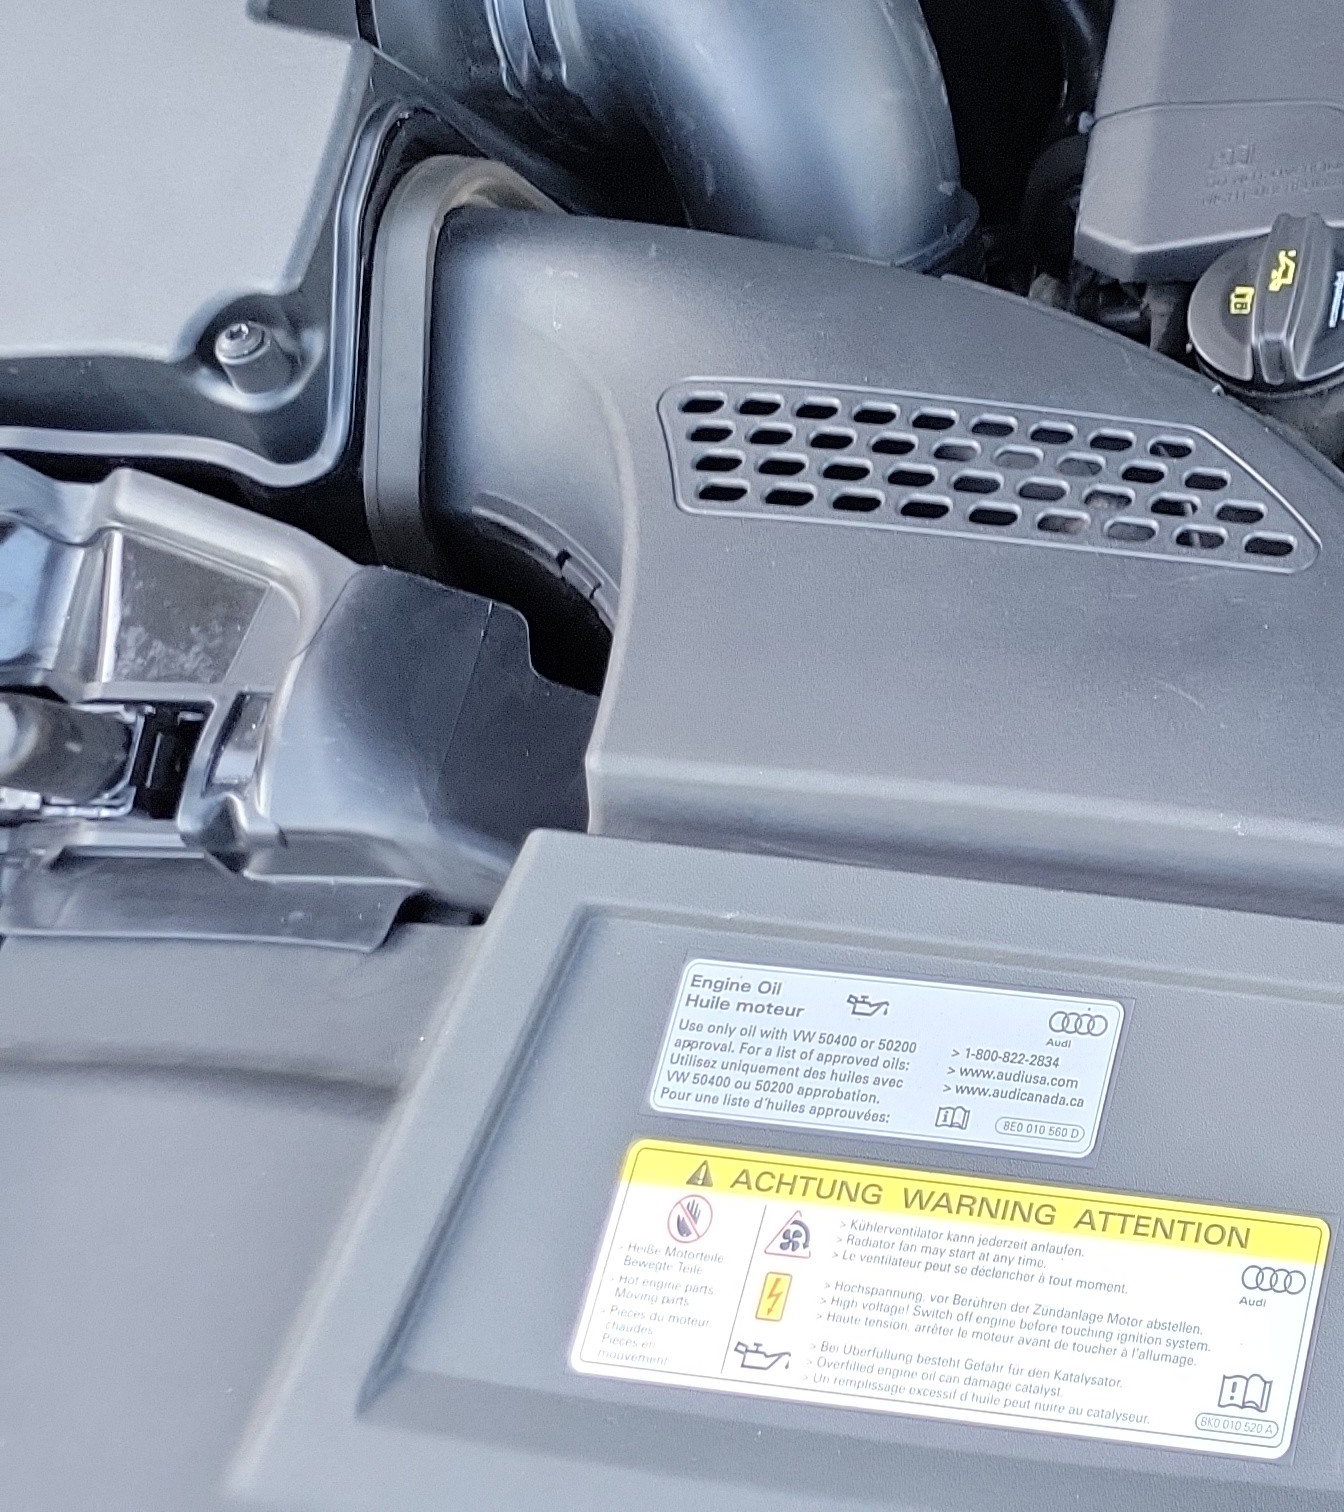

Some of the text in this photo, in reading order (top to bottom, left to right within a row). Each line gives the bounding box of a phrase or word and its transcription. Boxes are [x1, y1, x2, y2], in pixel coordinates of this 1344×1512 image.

[689, 973, 782, 996] Engine Oil
[684, 992, 805, 1018] Huile moteur
[678, 1017, 917, 1054] Use only oil with VW 50400 or 50200
[1044, 1037, 1072, 1048] Audi
[669, 1051, 904, 1088] Utilisez uniquement des huiles avec
[673, 1037, 910, 1071] approval. For a list of approved oils:
[965, 1046, 1060, 1069] 1-800-822-2834
[666, 1069, 880, 1104] VW 50400 ou 50200 approbation.
[958, 1065, 1079, 1089] www.audiusa.com
[659, 1085, 692, 1101] Pour
[693, 1092, 719, 1104] une
[721, 1092, 750, 1108] liste
[808, 1104, 890, 1124] approuvées:
[954, 1083, 1084, 1108] www.audicanada.ca
[1002, 1120, 1082, 1141] 8E0 010 560 D
[728, 1167, 1251, 1249] ACHTUNG WARNING ATTENTION
[845, 1233, 1046, 1269] Radiator fan may start at any time.
[849, 1218, 1084, 1257] Kühlerventilator kann jederzeit anlaufen.
[841, 1249, 856, 1261] Le
[859, 1253, 922, 1269] ventilateur
[923, 1260, 951, 1273] peut
[953, 1264, 968, 1275] se
[1037, 1271, 1045, 1284] à
[1047, 1274, 1073, 1288] tout
[1074, 1278, 1128, 1294] moment.
[660, 1294, 690, 1307] parts
[929, 1293, 950, 1304] vor
[1009, 1301, 1030, 1314] der
[1105, 1311, 1143, 1327] Motor
[1145, 1317, 1203, 1335] abstellen.
[1237, 1295, 1267, 1308] Audi
[666, 1312, 711, 1328] moteur
[829, 1295, 858, 1310] High
[911, 1303, 953, 1320] Switch
[955, 1310, 974, 1323] off
[1018, 1316, 1058, 1333] before
[1060, 1324, 1114, 1343] touching
[1115, 1331, 1162, 1346] ignition
[1164, 1337, 1211, 1352] system.
[825, 1310, 861, 1325] Haute
[913, 1322, 954, 1336] arrêter
[956, 1325, 968, 1338] le
[970, 1329, 1014, 1344] moteur
[1016, 1335, 1051, 1349] avant
[1053, 1338, 1069, 1351] de
[1071, 1341, 1117, 1356] toucher
[1119, 1346, 1128, 1358] à
[1130, 1346, 1197, 1368] l'allumage.
[816, 1355, 875, 1374] Overfilled
[920, 1370, 937, 1381] oil
[937, 1373, 960, 1384] can
[962, 1374, 1012, 1393] damage
[915, 1352, 960, 1368] besteht
[963, 1357, 1004, 1373] Gefahr
[1026, 1366, 1050, 1379] den
[1052, 1368, 1122, 1388] Katalysator.
[907, 1384, 957, 1400] excessif
[1002, 1397, 1031, 1409] peut
[1067, 1405, 1083, 1416] au
[1221, 1418, 1242, 1431] 010
[1243, 1420, 1263, 1434] 520
